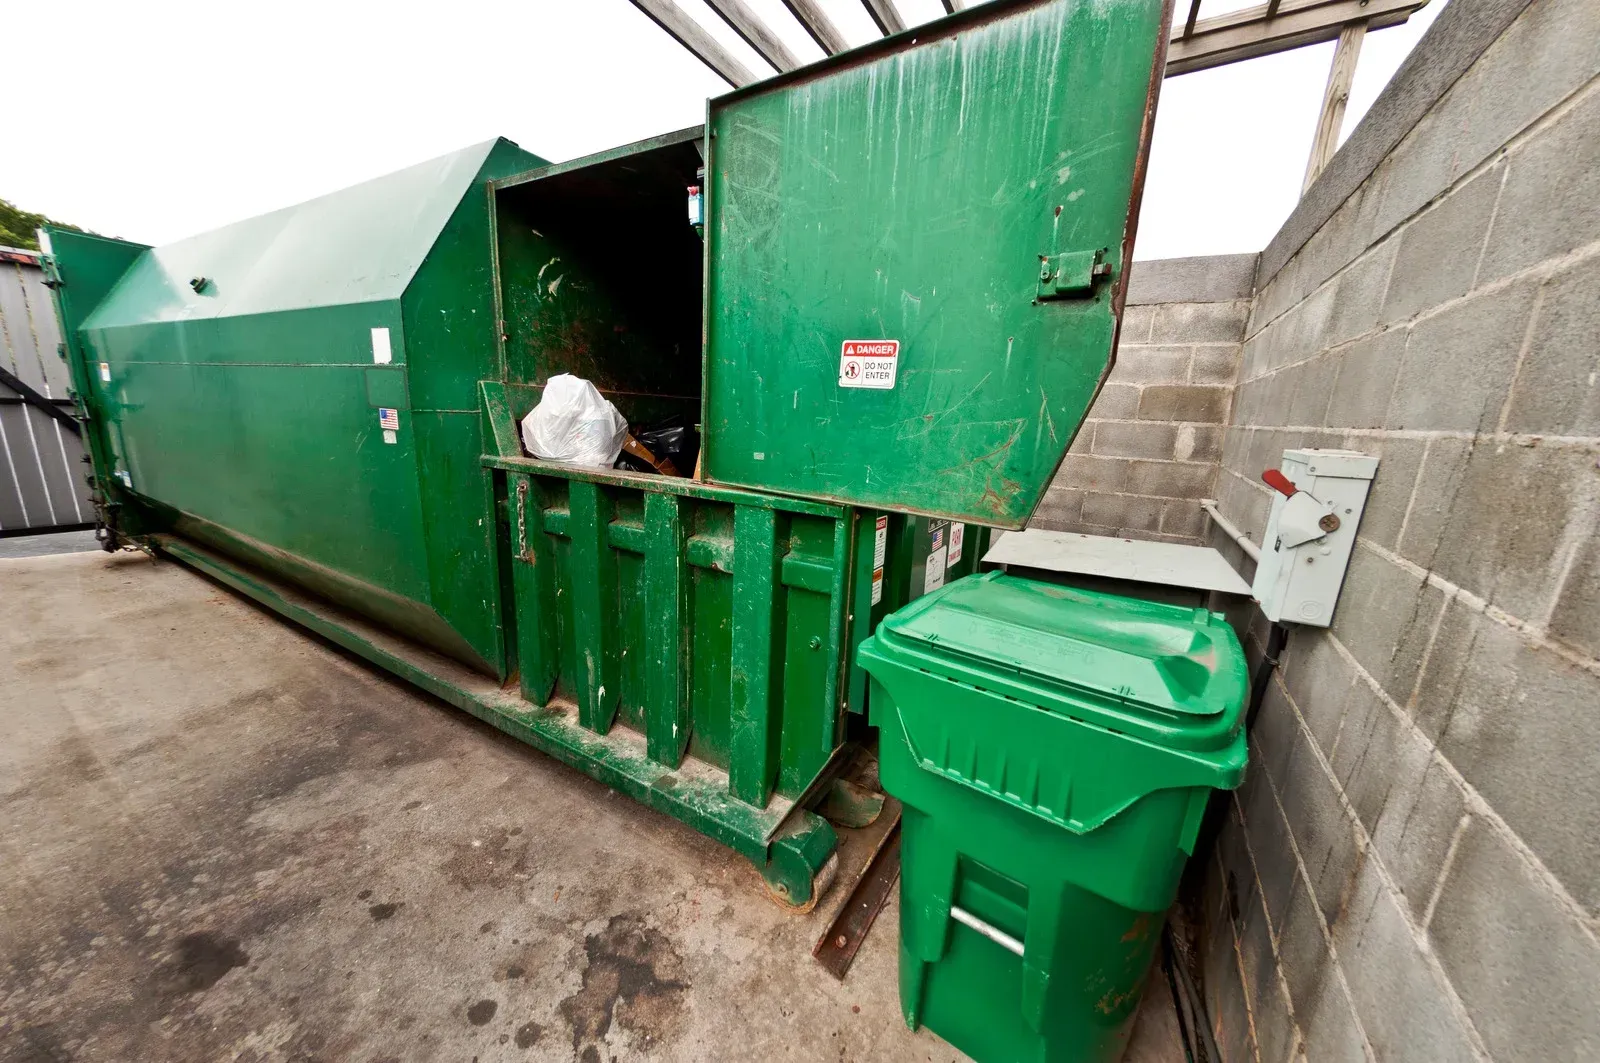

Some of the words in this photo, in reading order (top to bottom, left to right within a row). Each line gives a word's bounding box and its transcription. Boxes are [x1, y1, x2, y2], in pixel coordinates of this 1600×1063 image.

[856, 345, 894, 354] DANGER
[865, 362, 876, 370] DO
[877, 362, 893, 370] NOT
